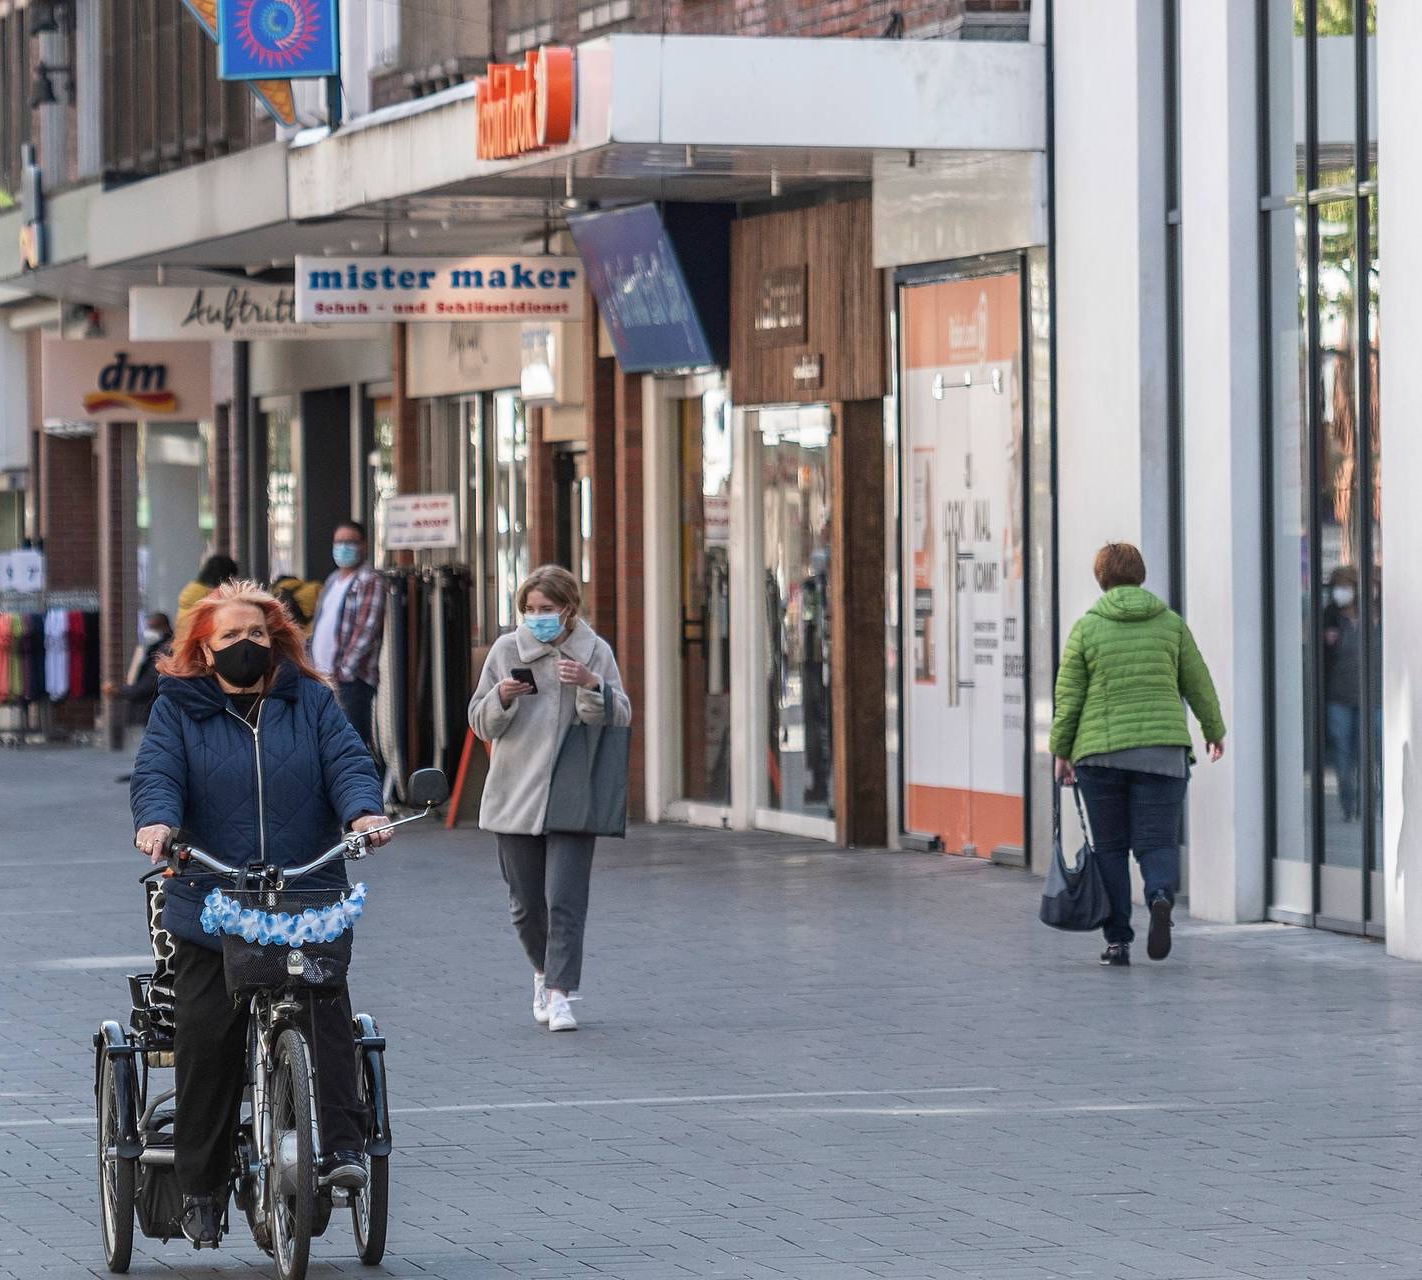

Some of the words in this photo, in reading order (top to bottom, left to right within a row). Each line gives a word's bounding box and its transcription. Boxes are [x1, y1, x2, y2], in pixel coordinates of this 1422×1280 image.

[308, 264, 435, 289] mister
[451, 264, 576, 289] maker
[314, 303, 369, 315] Schuh
[99, 352, 168, 391] dm
